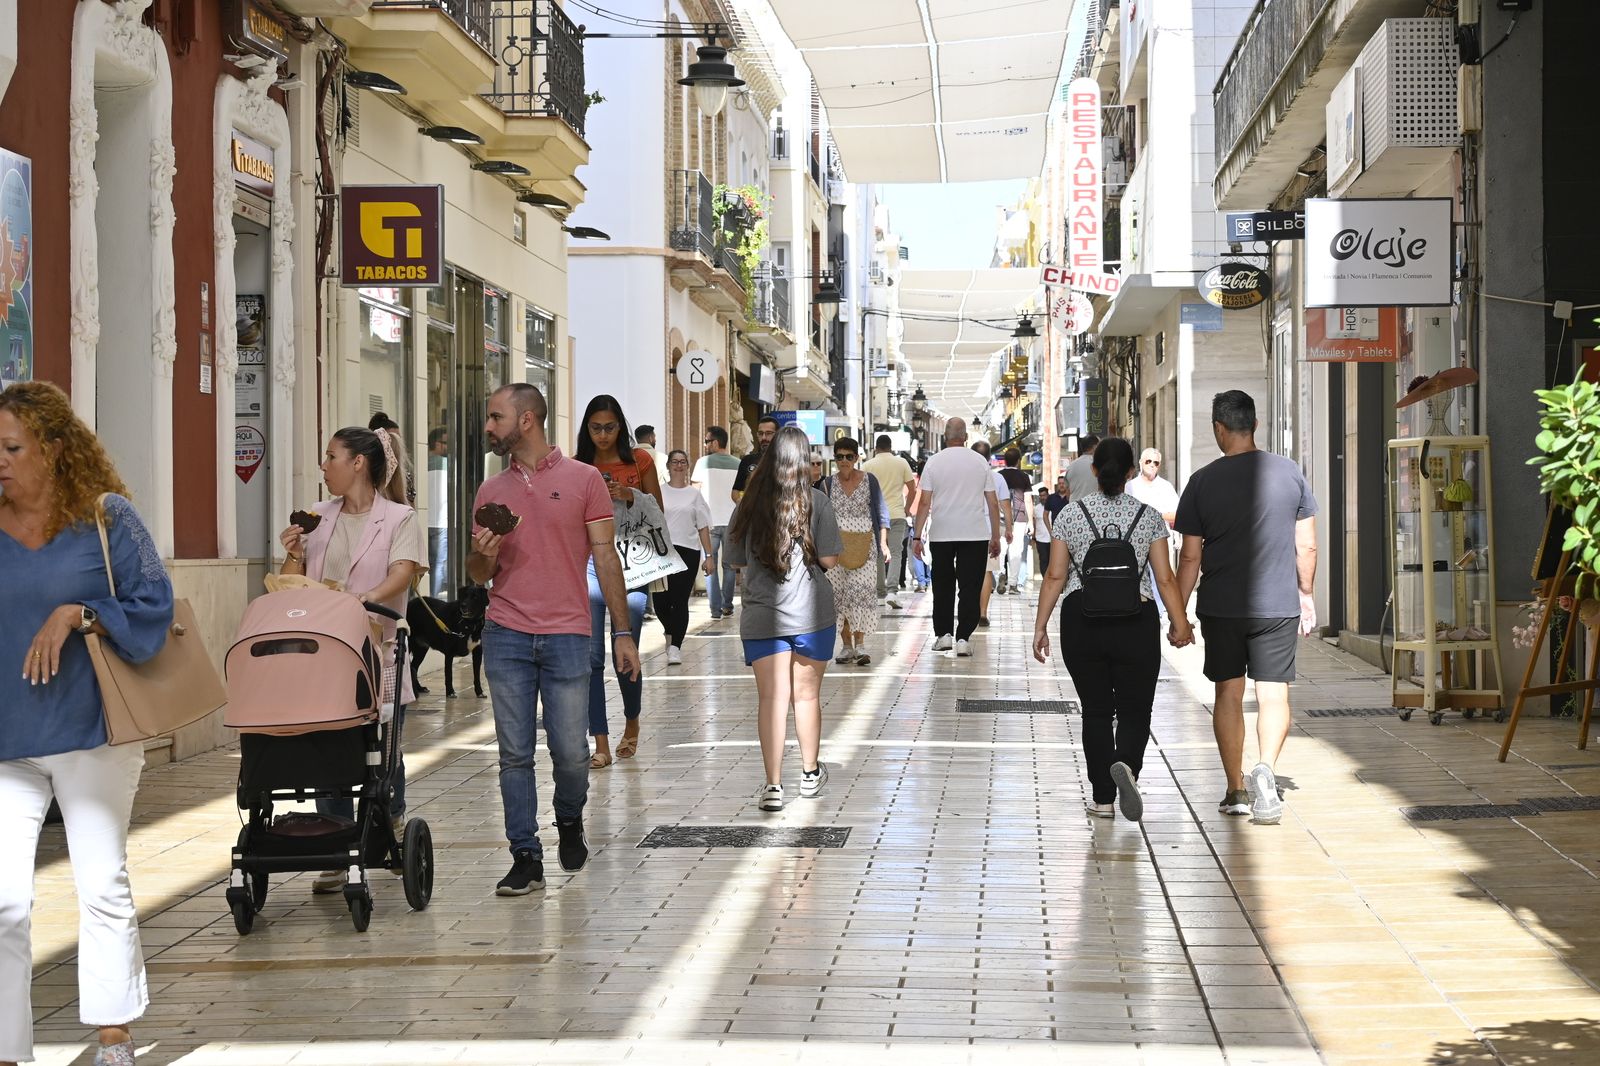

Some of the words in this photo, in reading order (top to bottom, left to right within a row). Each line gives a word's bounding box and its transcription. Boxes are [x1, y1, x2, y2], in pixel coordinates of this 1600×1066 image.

[244, 153, 274, 183] TABACOS
[1073, 93, 1097, 267] RESTAURANTE
[1329, 227, 1427, 268] Olaje
[355, 265, 427, 280] TABACOS
[1043, 267, 1119, 292] CHINO
[1350, 271, 1367, 279] Novia
[1371, 271, 1399, 279] Flamenca
[1349, 350, 1354, 360] y
[1358, 346, 1393, 357] Tablets
